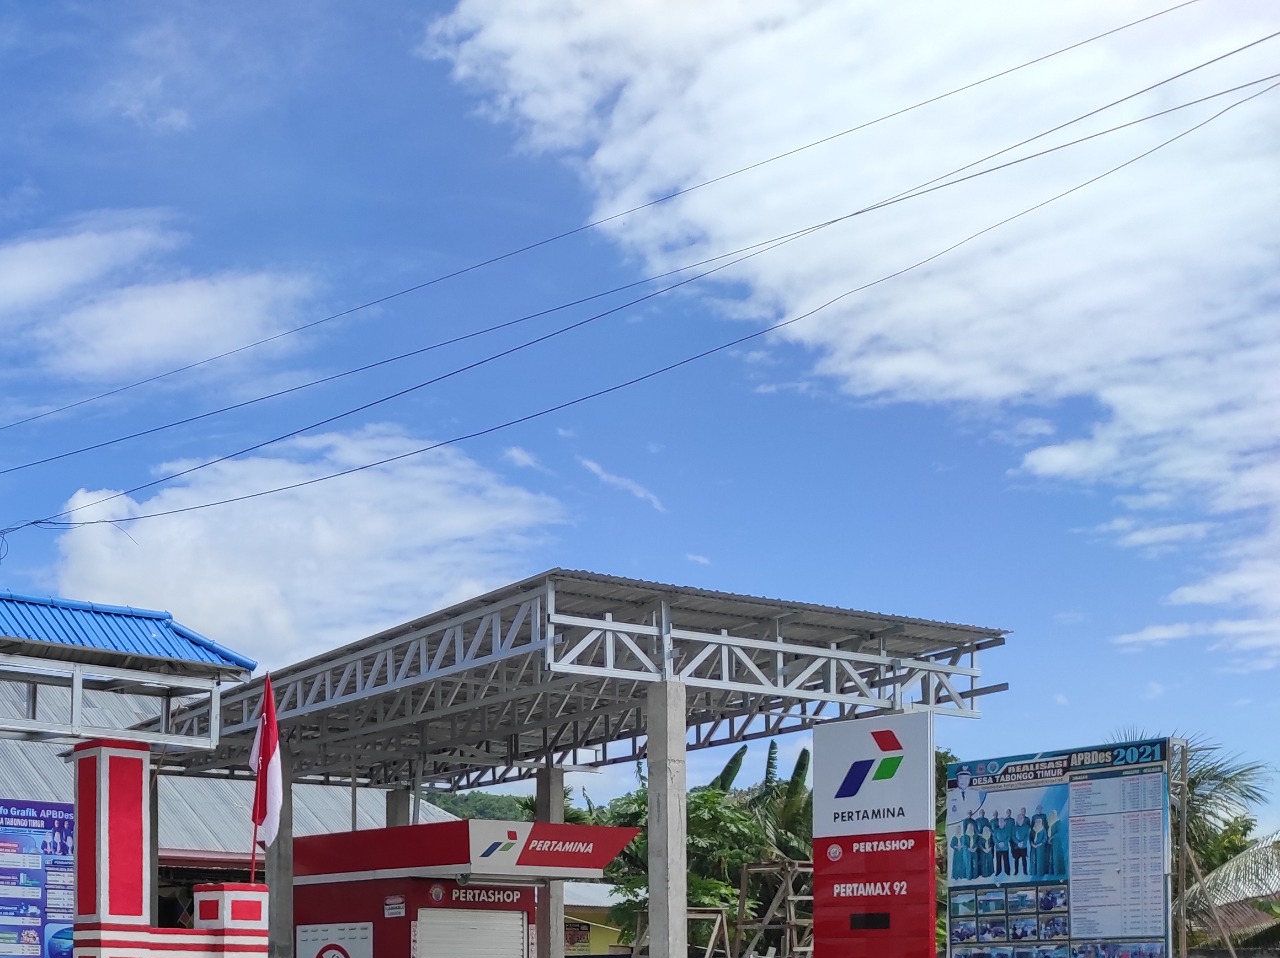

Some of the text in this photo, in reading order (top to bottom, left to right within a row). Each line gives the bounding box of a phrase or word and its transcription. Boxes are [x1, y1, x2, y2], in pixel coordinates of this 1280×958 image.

[1070, 744, 1161, 767] APBDes 2021
[1008, 760, 1068, 774] REALISASI
[972, 776, 993, 786] DESA
[995, 771, 1035, 783] TABONGO
[1036, 768, 1063, 779] TIMUR
[10, 806, 37, 818] Grafik
[39, 809, 74, 820] APBDes
[833, 806, 906, 823] PERTAMINA
[4, 817, 28, 828] TABONGO
[28, 819, 45, 829] TIMUR
[528, 840, 594, 854] PERTAMINA
[852, 839, 916, 853] PERTASHOP
[452, 889, 521, 903] PERTASHOP
[833, 881, 908, 897] PERTAMAX 92
